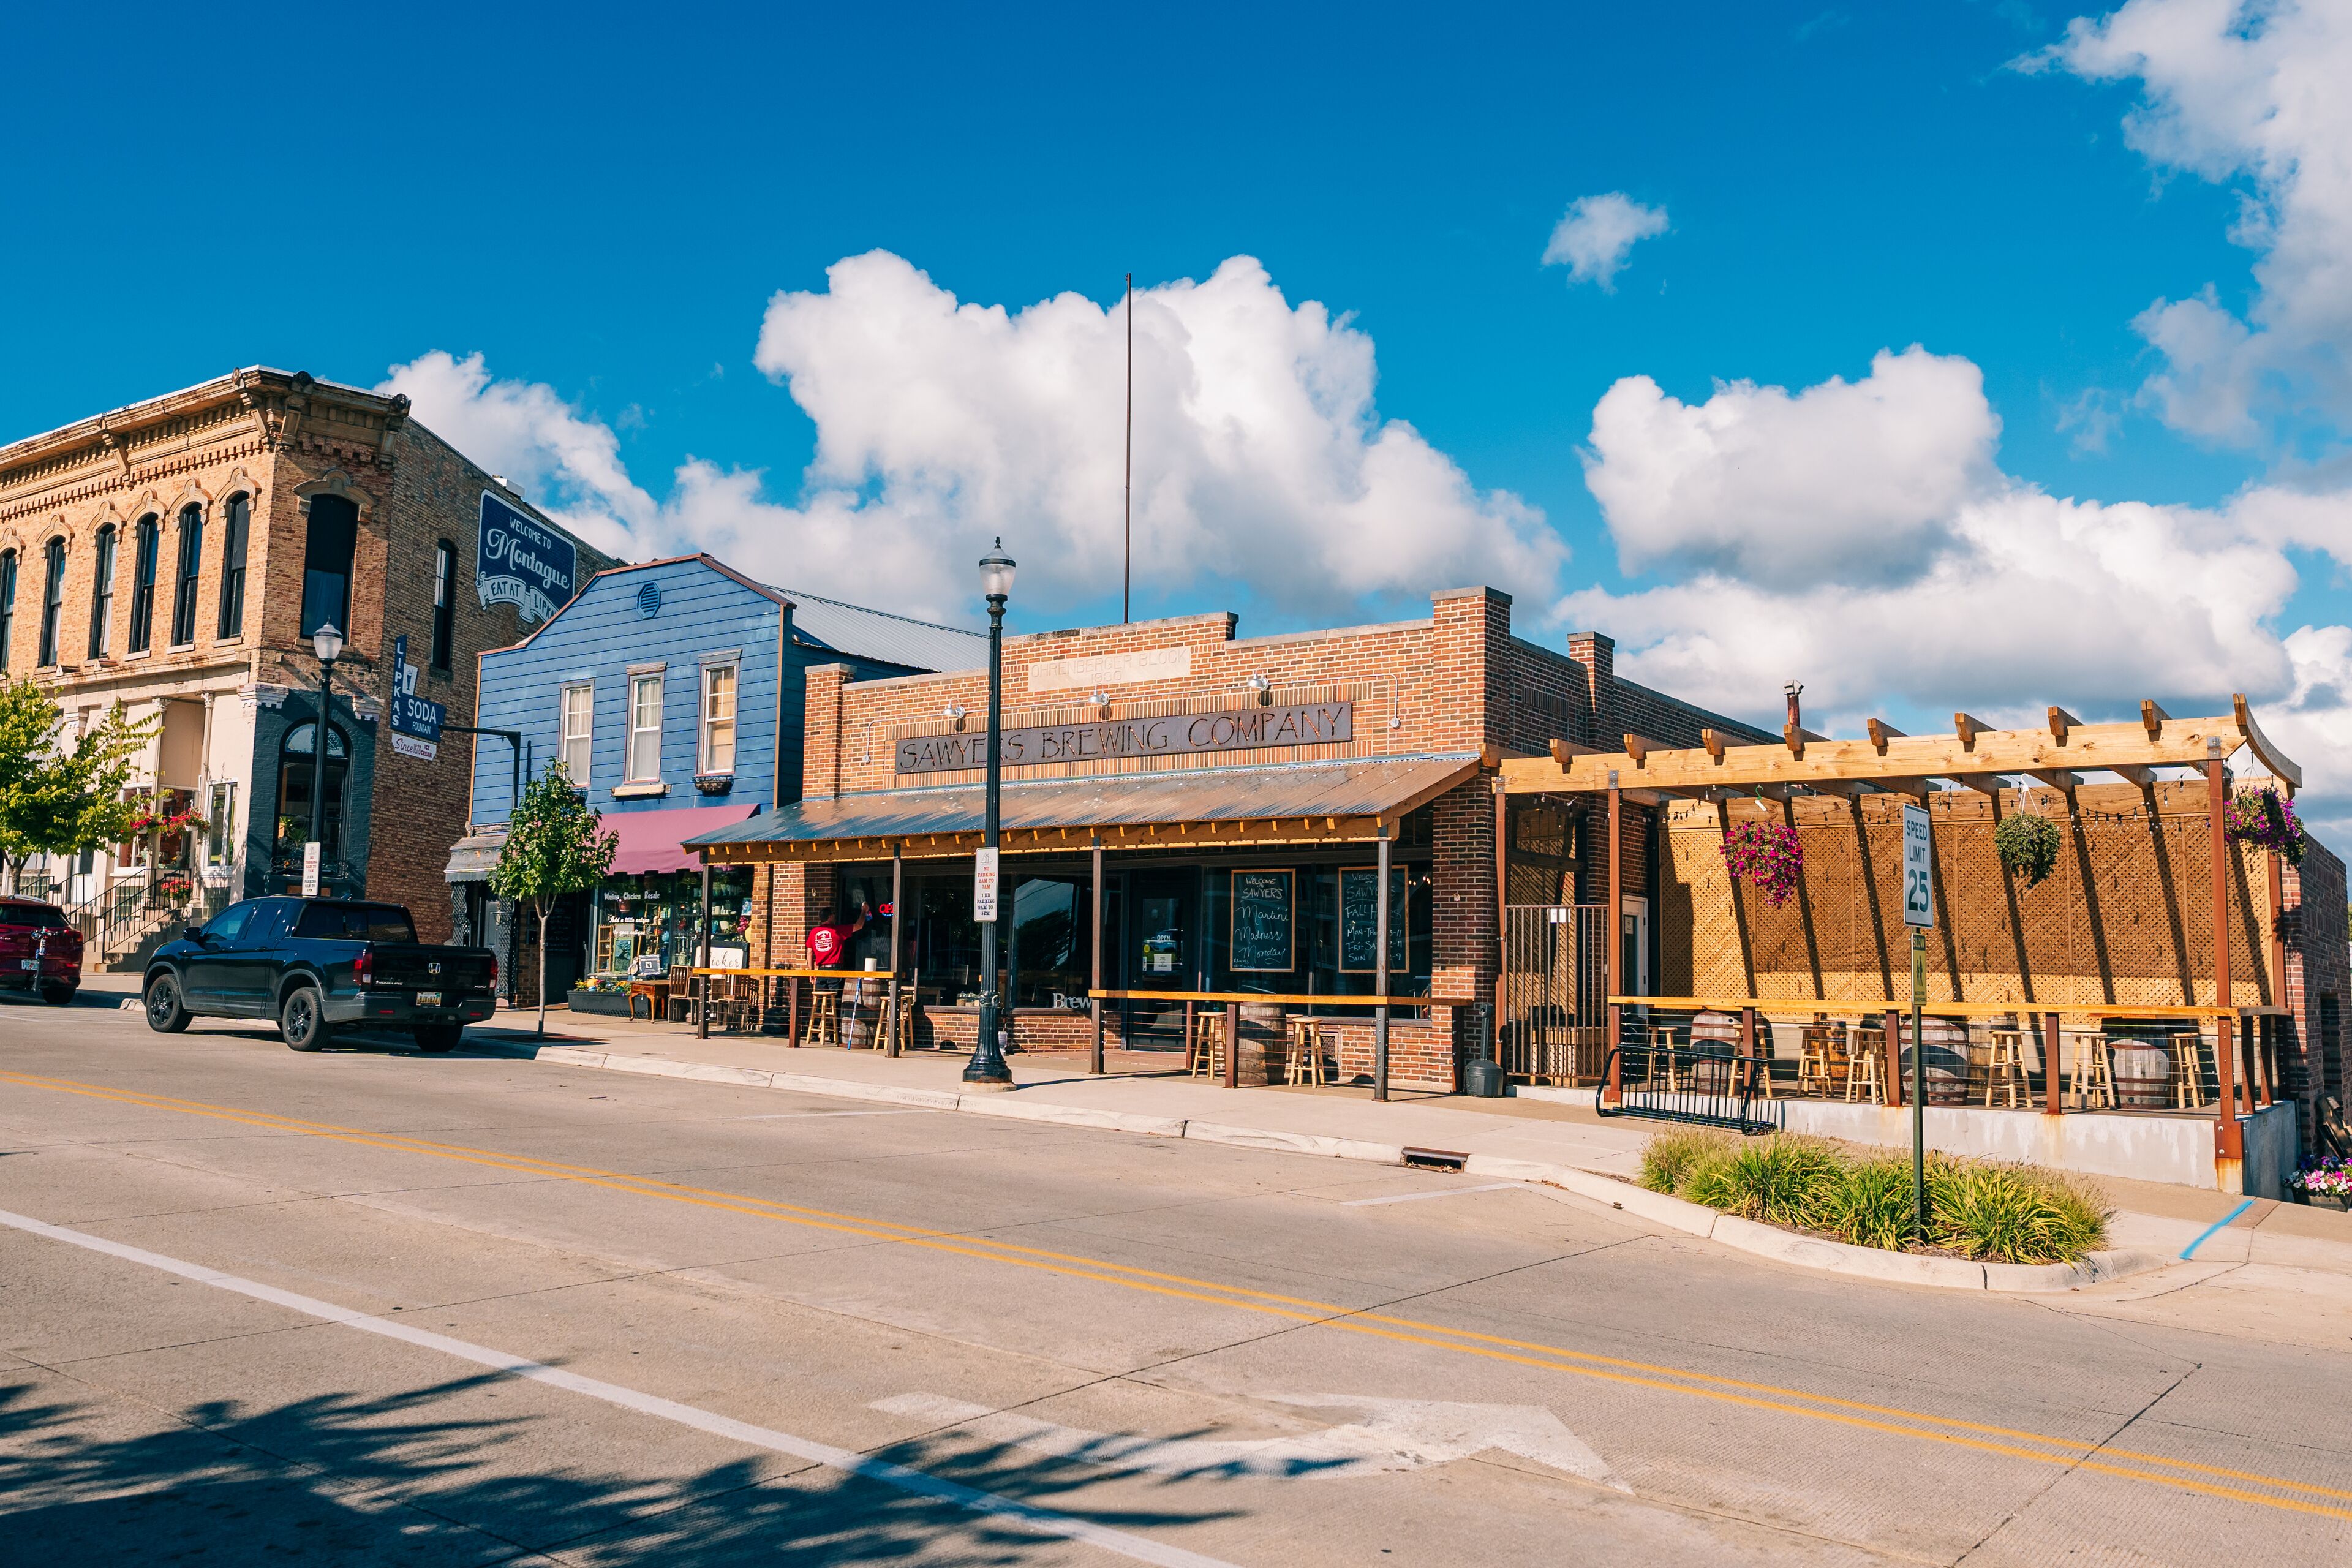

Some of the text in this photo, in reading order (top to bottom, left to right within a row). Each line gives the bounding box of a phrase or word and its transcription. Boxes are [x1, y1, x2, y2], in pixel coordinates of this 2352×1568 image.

[510, 516, 551, 549] WELCOME TO
[486, 529, 570, 589] Montague
[491, 581, 521, 597] EAT AT
[1031, 648, 1188, 678] OHRENBERGER BLOCK
[392, 643, 404, 726] LIPKA'S
[407, 699, 437, 724] SODA
[412, 721, 431, 734] FOUNTAIN
[1041, 722, 1167, 759] BREWING
[1188, 707, 1343, 747] COMPANY
[395, 737, 413, 753] Since
[1907, 820, 1928, 841] SPEED
[1909, 844, 1926, 864] LIMIT
[1246, 875, 1276, 884] WELCOME
[1241, 888, 1283, 900] SAWYERS
[1908, 869, 1929, 913] 25
[1235, 905, 1290, 925] Martini
[1235, 926, 1283, 944] Madness
[1238, 944, 1286, 965] Monday
[1052, 993, 1093, 1009] Brew
